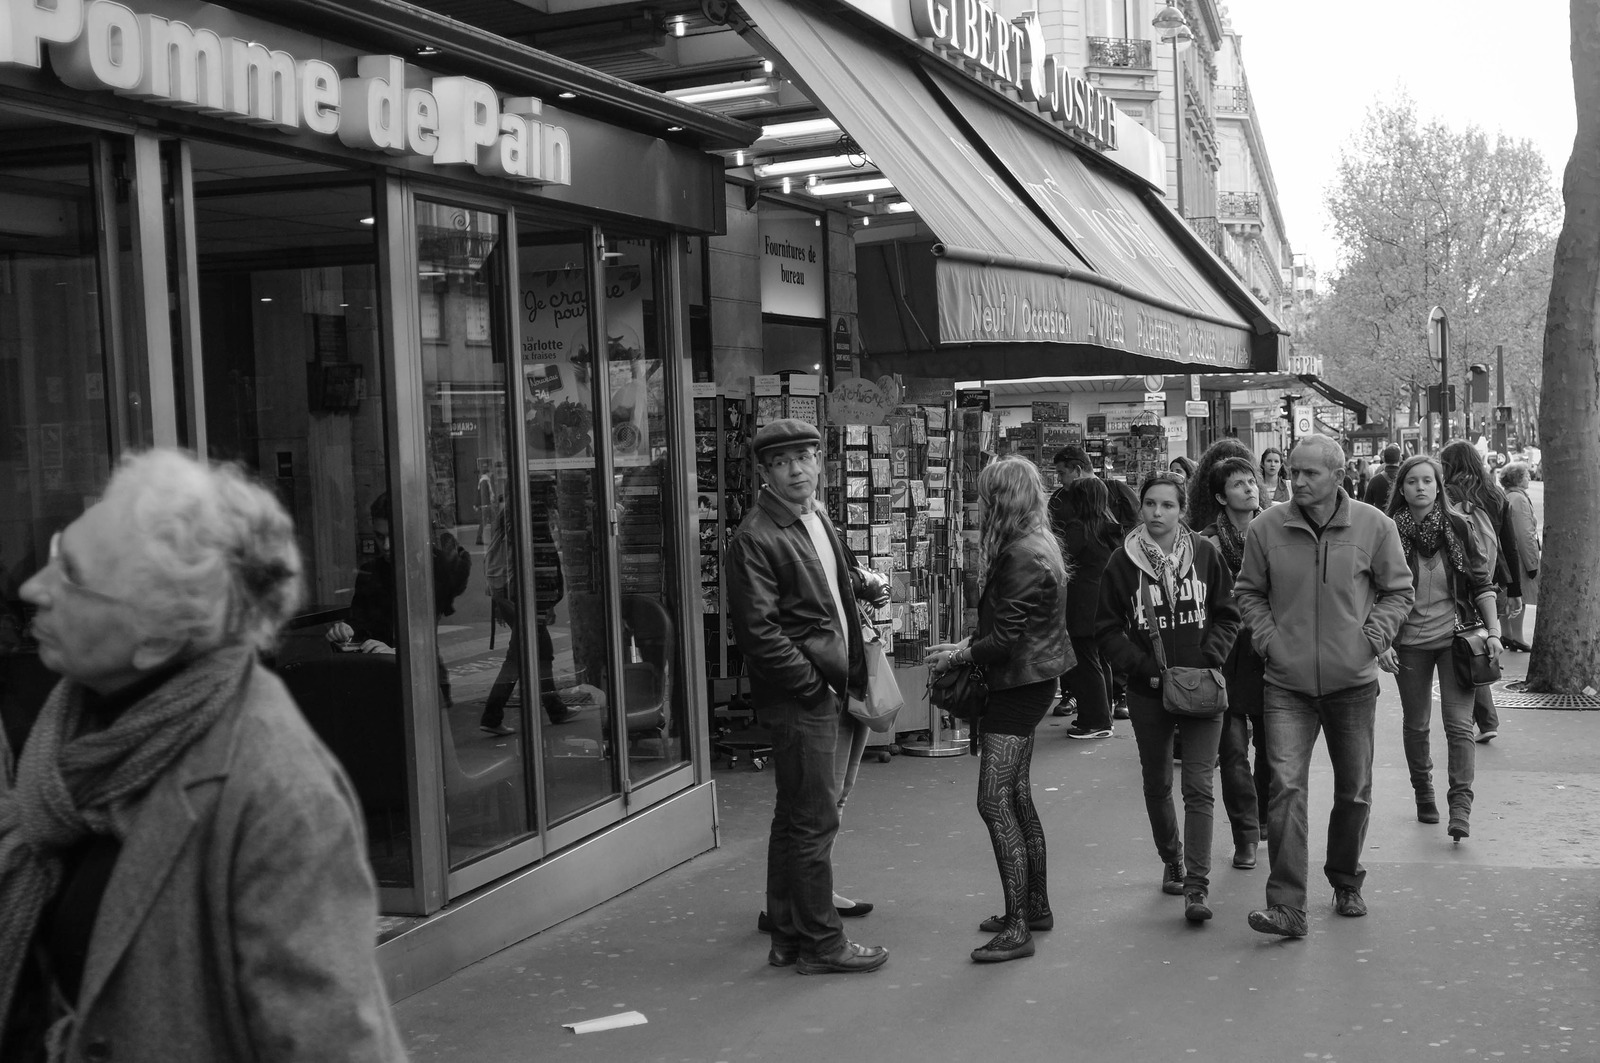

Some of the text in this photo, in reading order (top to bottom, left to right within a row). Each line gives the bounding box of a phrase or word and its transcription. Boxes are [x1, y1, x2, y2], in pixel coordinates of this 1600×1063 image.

[8, 0, 571, 186] Pomme de Pain
[926, 0, 1118, 150] GIBERT JOSEPH
[764, 234, 817, 264] Fournitures de
[780, 263, 805, 286] bureau
[970, 293, 1007, 332] Neuf
[1022, 297, 1072, 335] Occasion
[1087, 297, 1125, 344] LIVRES
